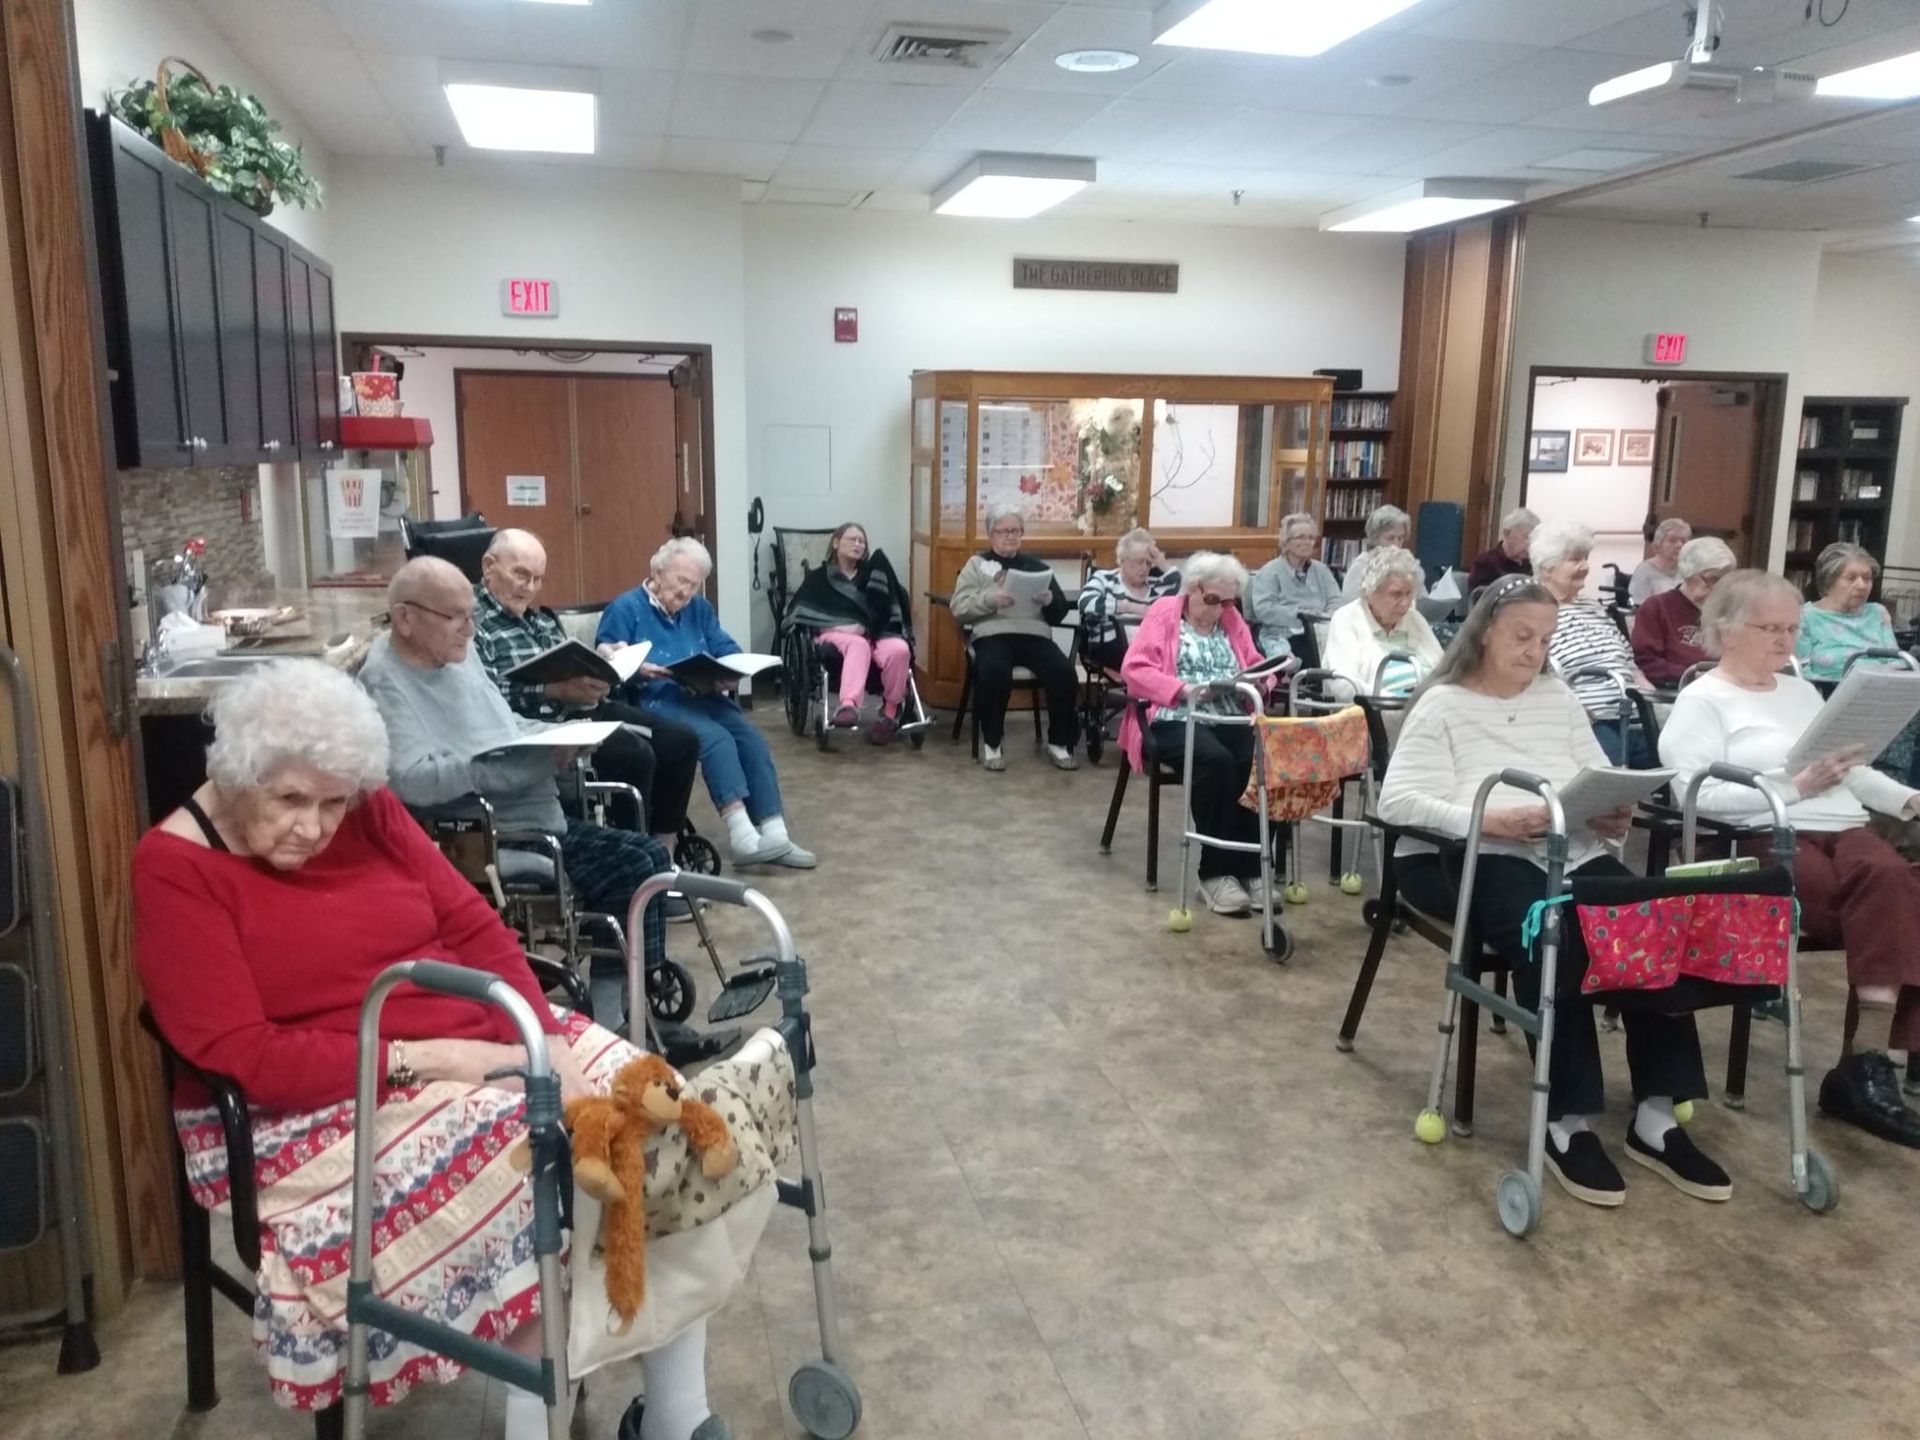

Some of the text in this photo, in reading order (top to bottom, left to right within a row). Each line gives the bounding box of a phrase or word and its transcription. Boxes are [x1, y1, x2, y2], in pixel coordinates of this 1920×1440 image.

[1022, 262, 1173, 289] THE GATHERING PLACE
[510, 279, 550, 312] EXIT
[1656, 335, 1685, 360] EXIT
